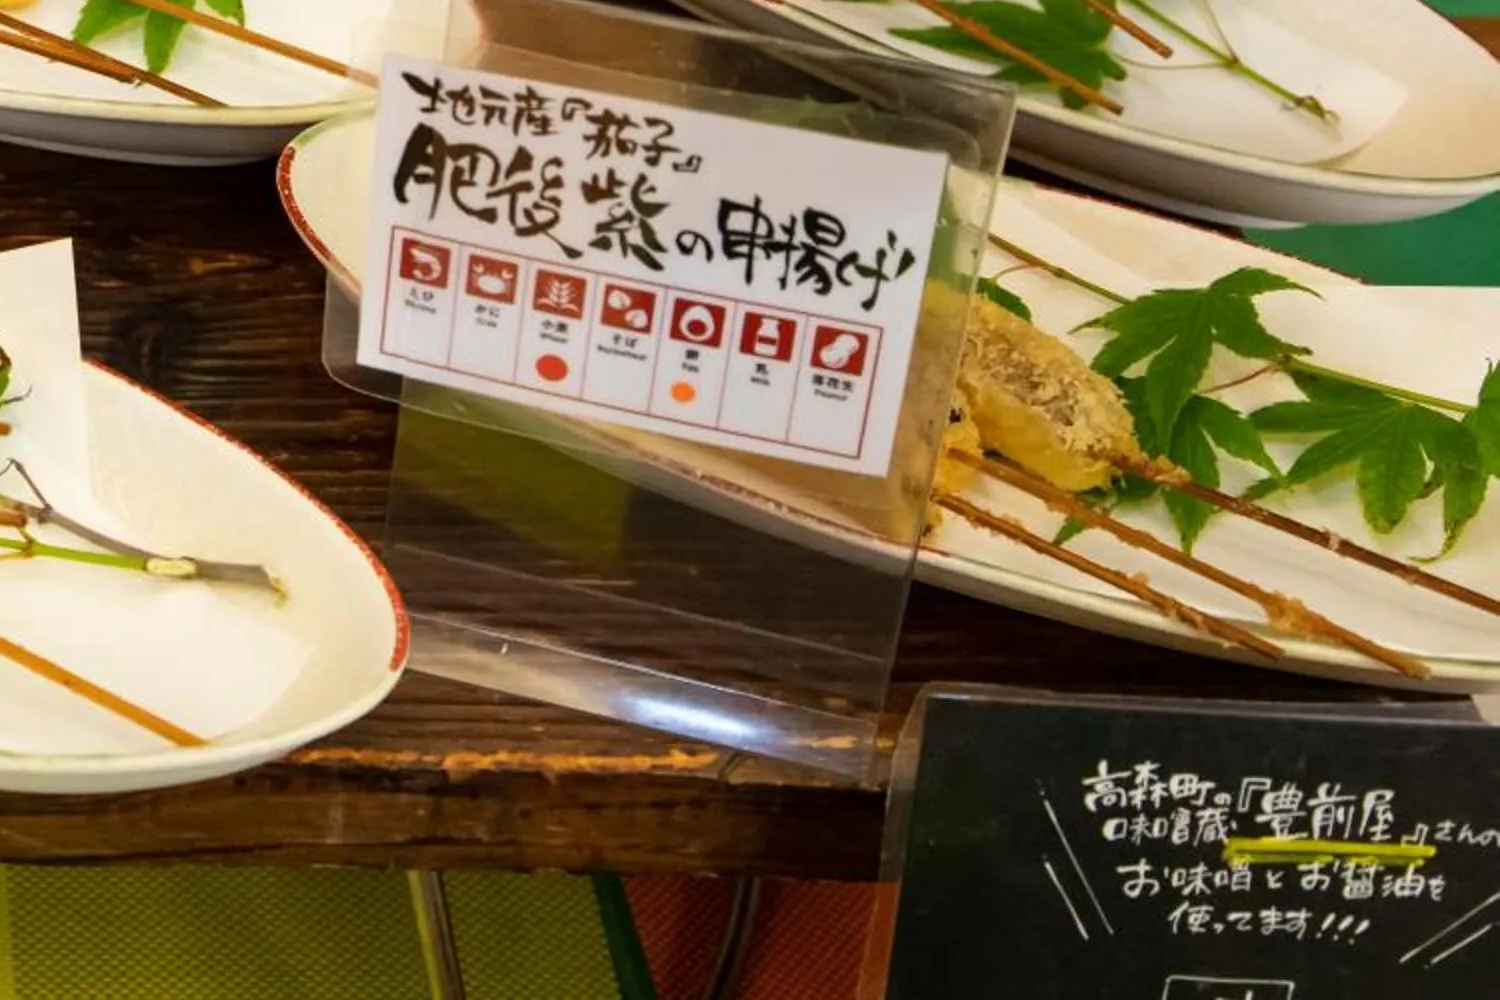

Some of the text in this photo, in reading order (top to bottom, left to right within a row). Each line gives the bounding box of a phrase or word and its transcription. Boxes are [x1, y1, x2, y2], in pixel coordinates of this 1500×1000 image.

[394, 124, 916, 310] 肥後紫の串揚げ
